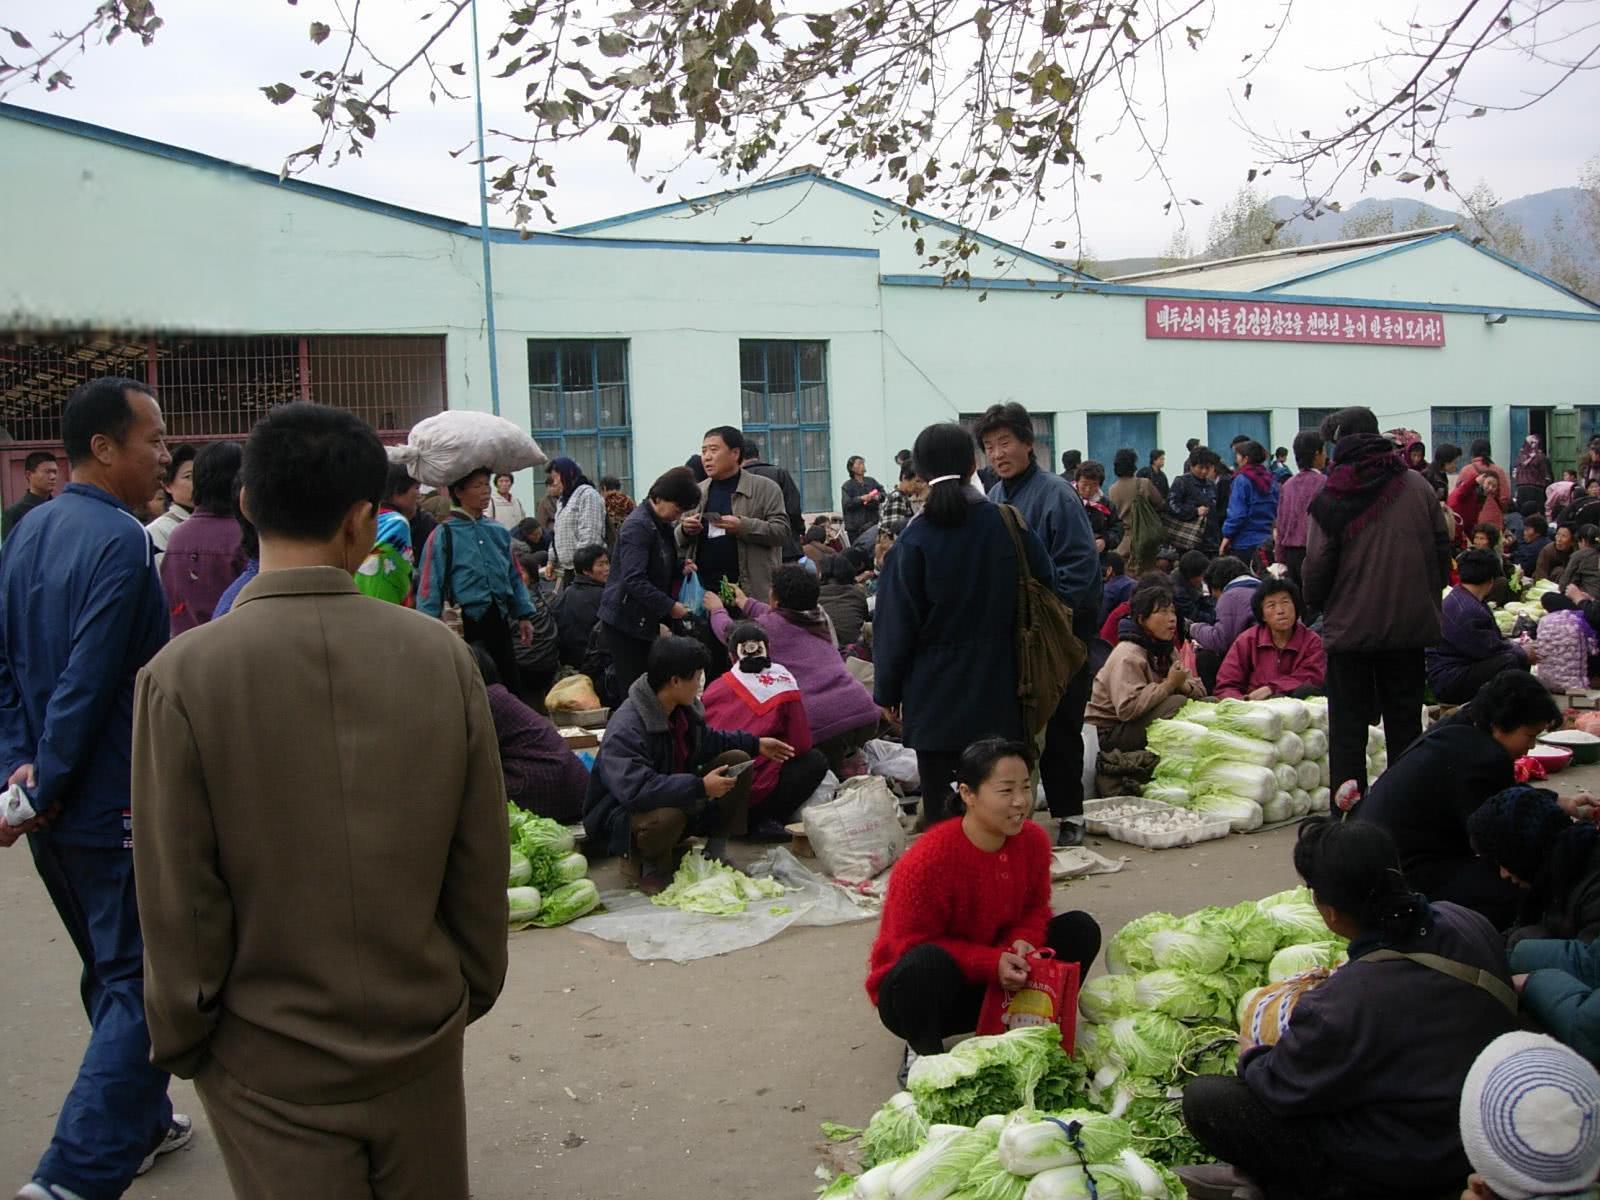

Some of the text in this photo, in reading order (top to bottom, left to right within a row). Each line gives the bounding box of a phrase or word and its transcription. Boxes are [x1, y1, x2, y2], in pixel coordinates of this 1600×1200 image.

[1156, 305, 1205, 333] 백두산의
[1207, 307, 1231, 334] 아들
[1233, 306, 1304, 336] 김정일장군을
[1306, 311, 1340, 336] 천만년
[1343, 314, 1367, 338] 높이
